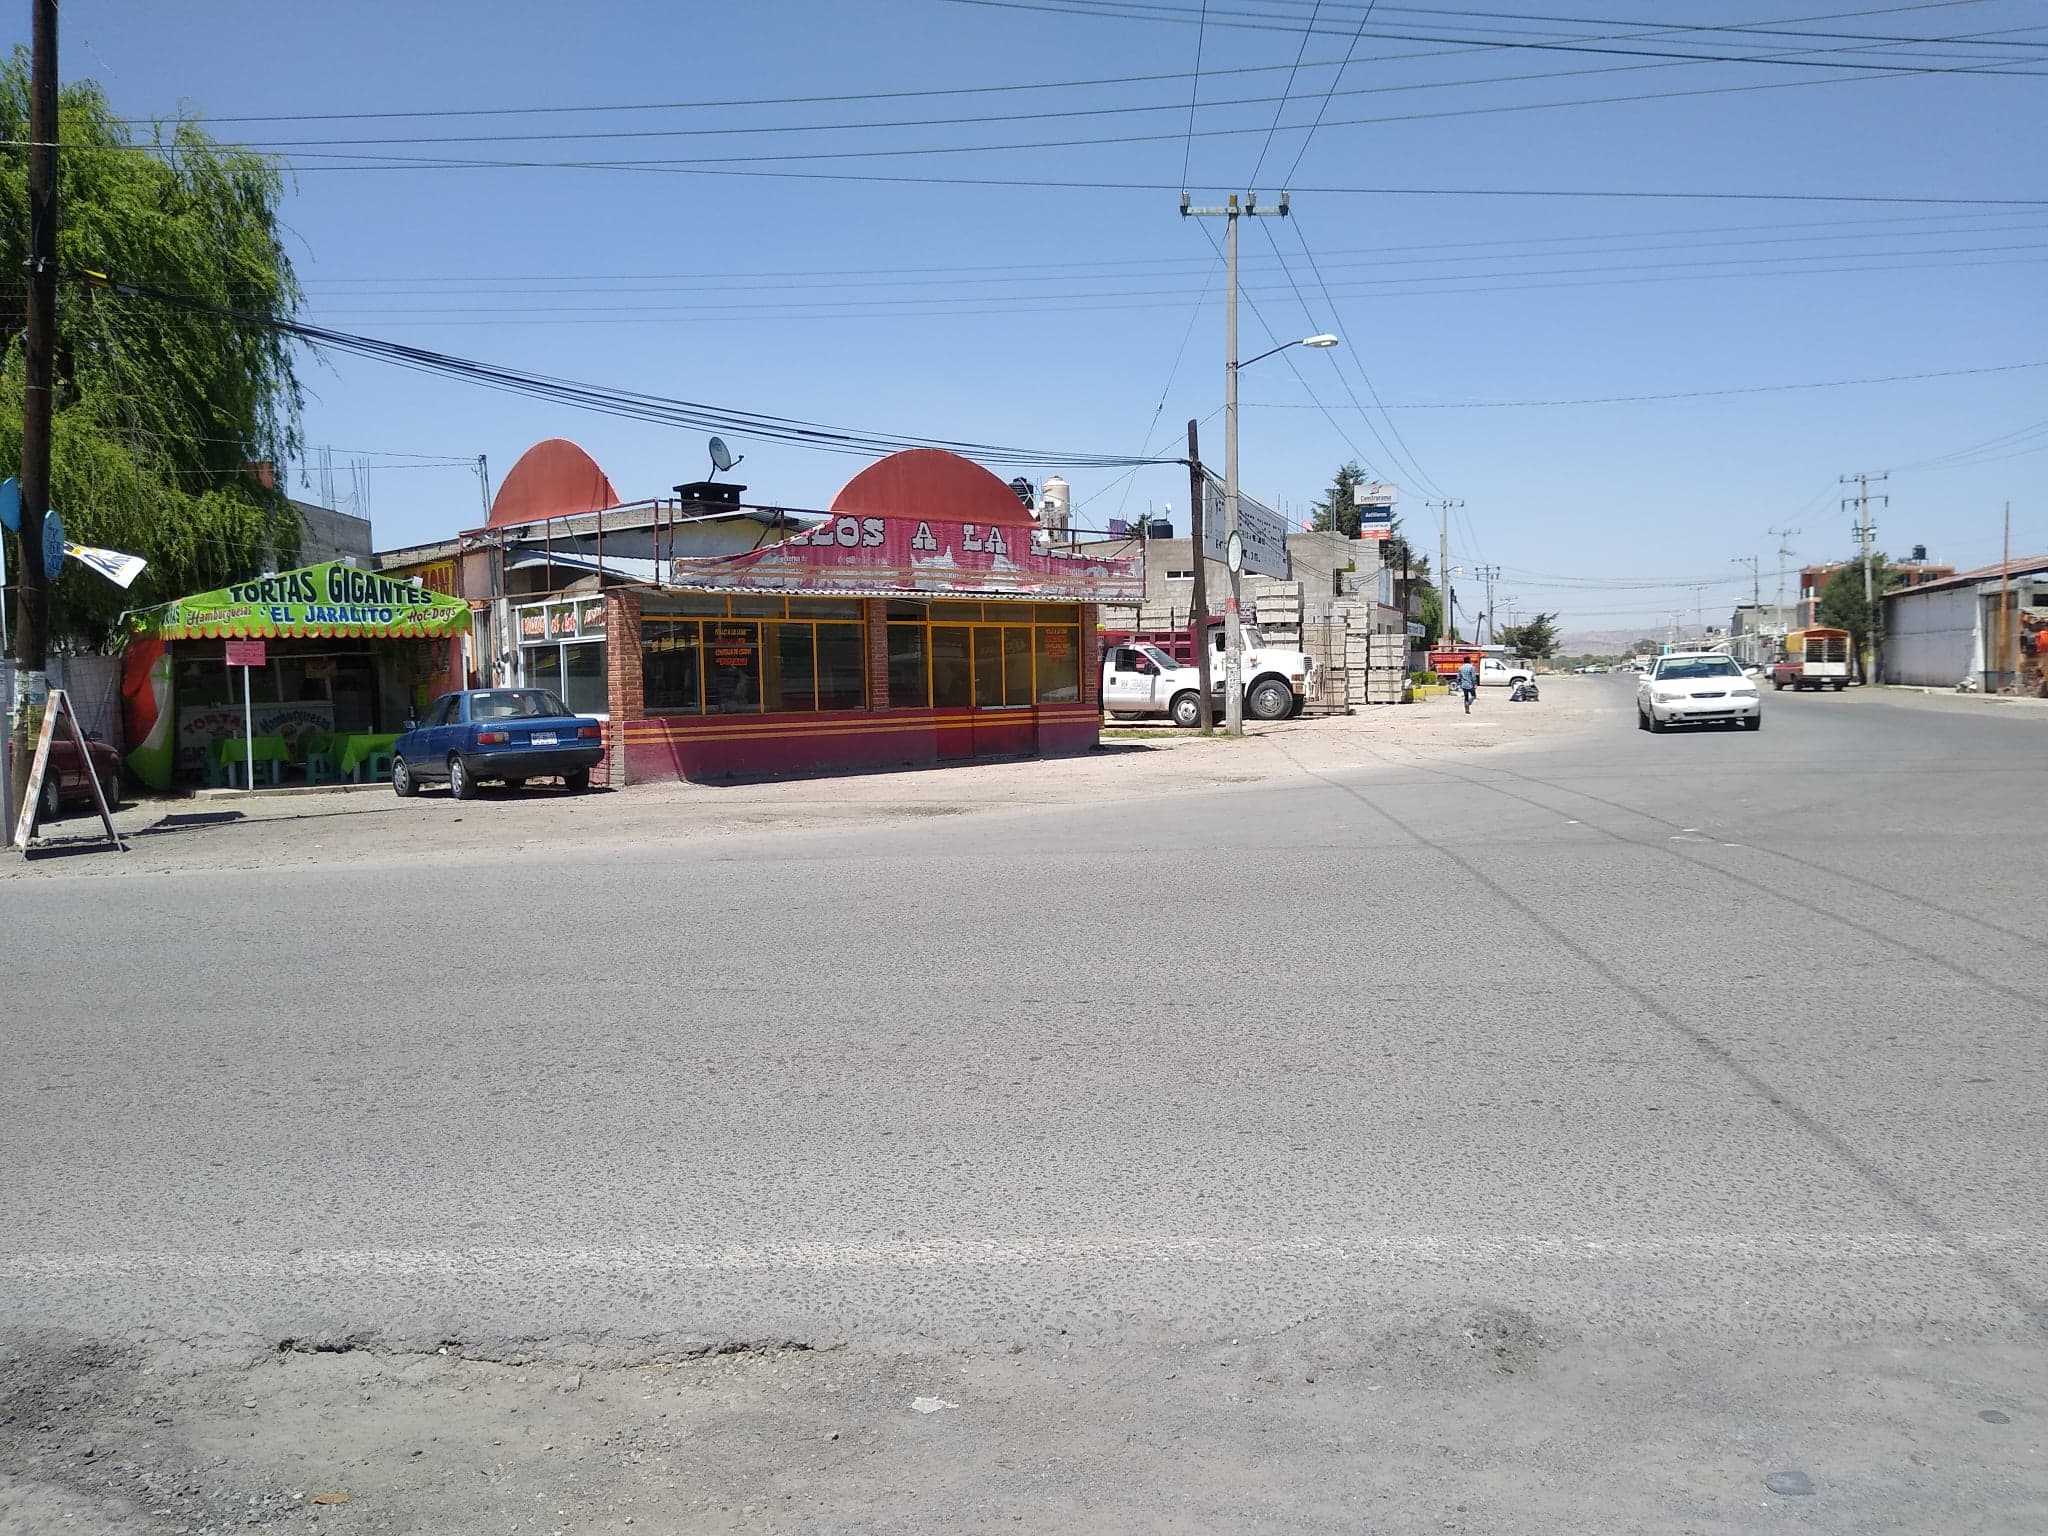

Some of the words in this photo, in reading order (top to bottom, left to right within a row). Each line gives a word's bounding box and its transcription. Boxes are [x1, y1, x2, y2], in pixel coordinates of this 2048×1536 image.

[911, 521, 937, 551] A
[962, 523, 1007, 554] LA
[229, 571, 317, 603] TORTAS
[328, 566, 432, 604] GIGANTES
[186, 607, 252, 626] Hamburguesas
[407, 607, 457, 624] Hot-Dogs
